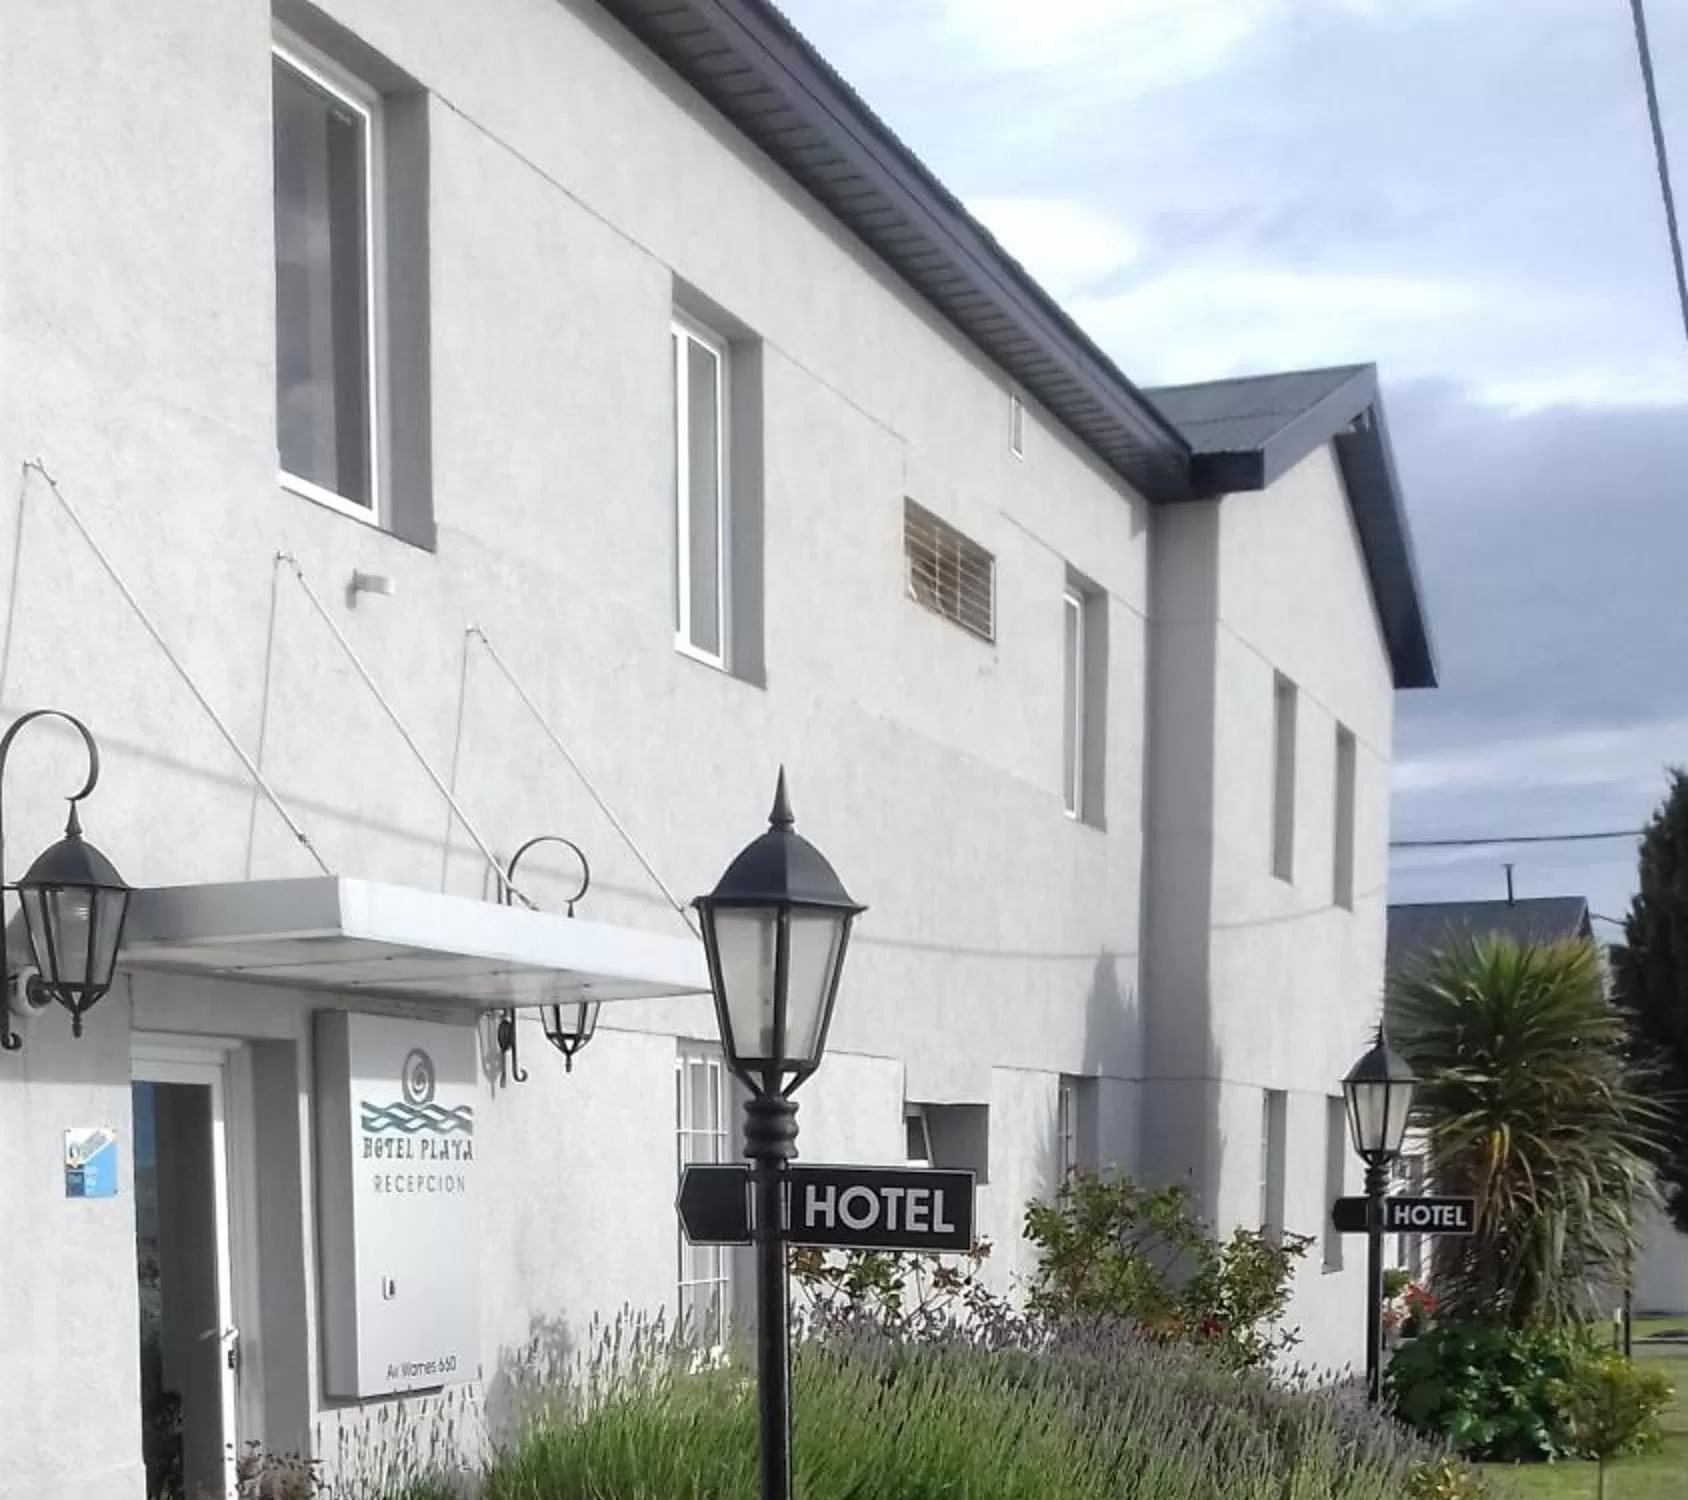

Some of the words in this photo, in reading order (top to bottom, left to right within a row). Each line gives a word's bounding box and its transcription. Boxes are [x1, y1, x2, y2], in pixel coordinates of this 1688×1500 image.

[362, 1136, 414, 1159] HOTEL
[420, 1138, 474, 1161] PLAYA
[804, 1184, 956, 1234] HOTEL
[1394, 1204, 1467, 1227] HOTEL
